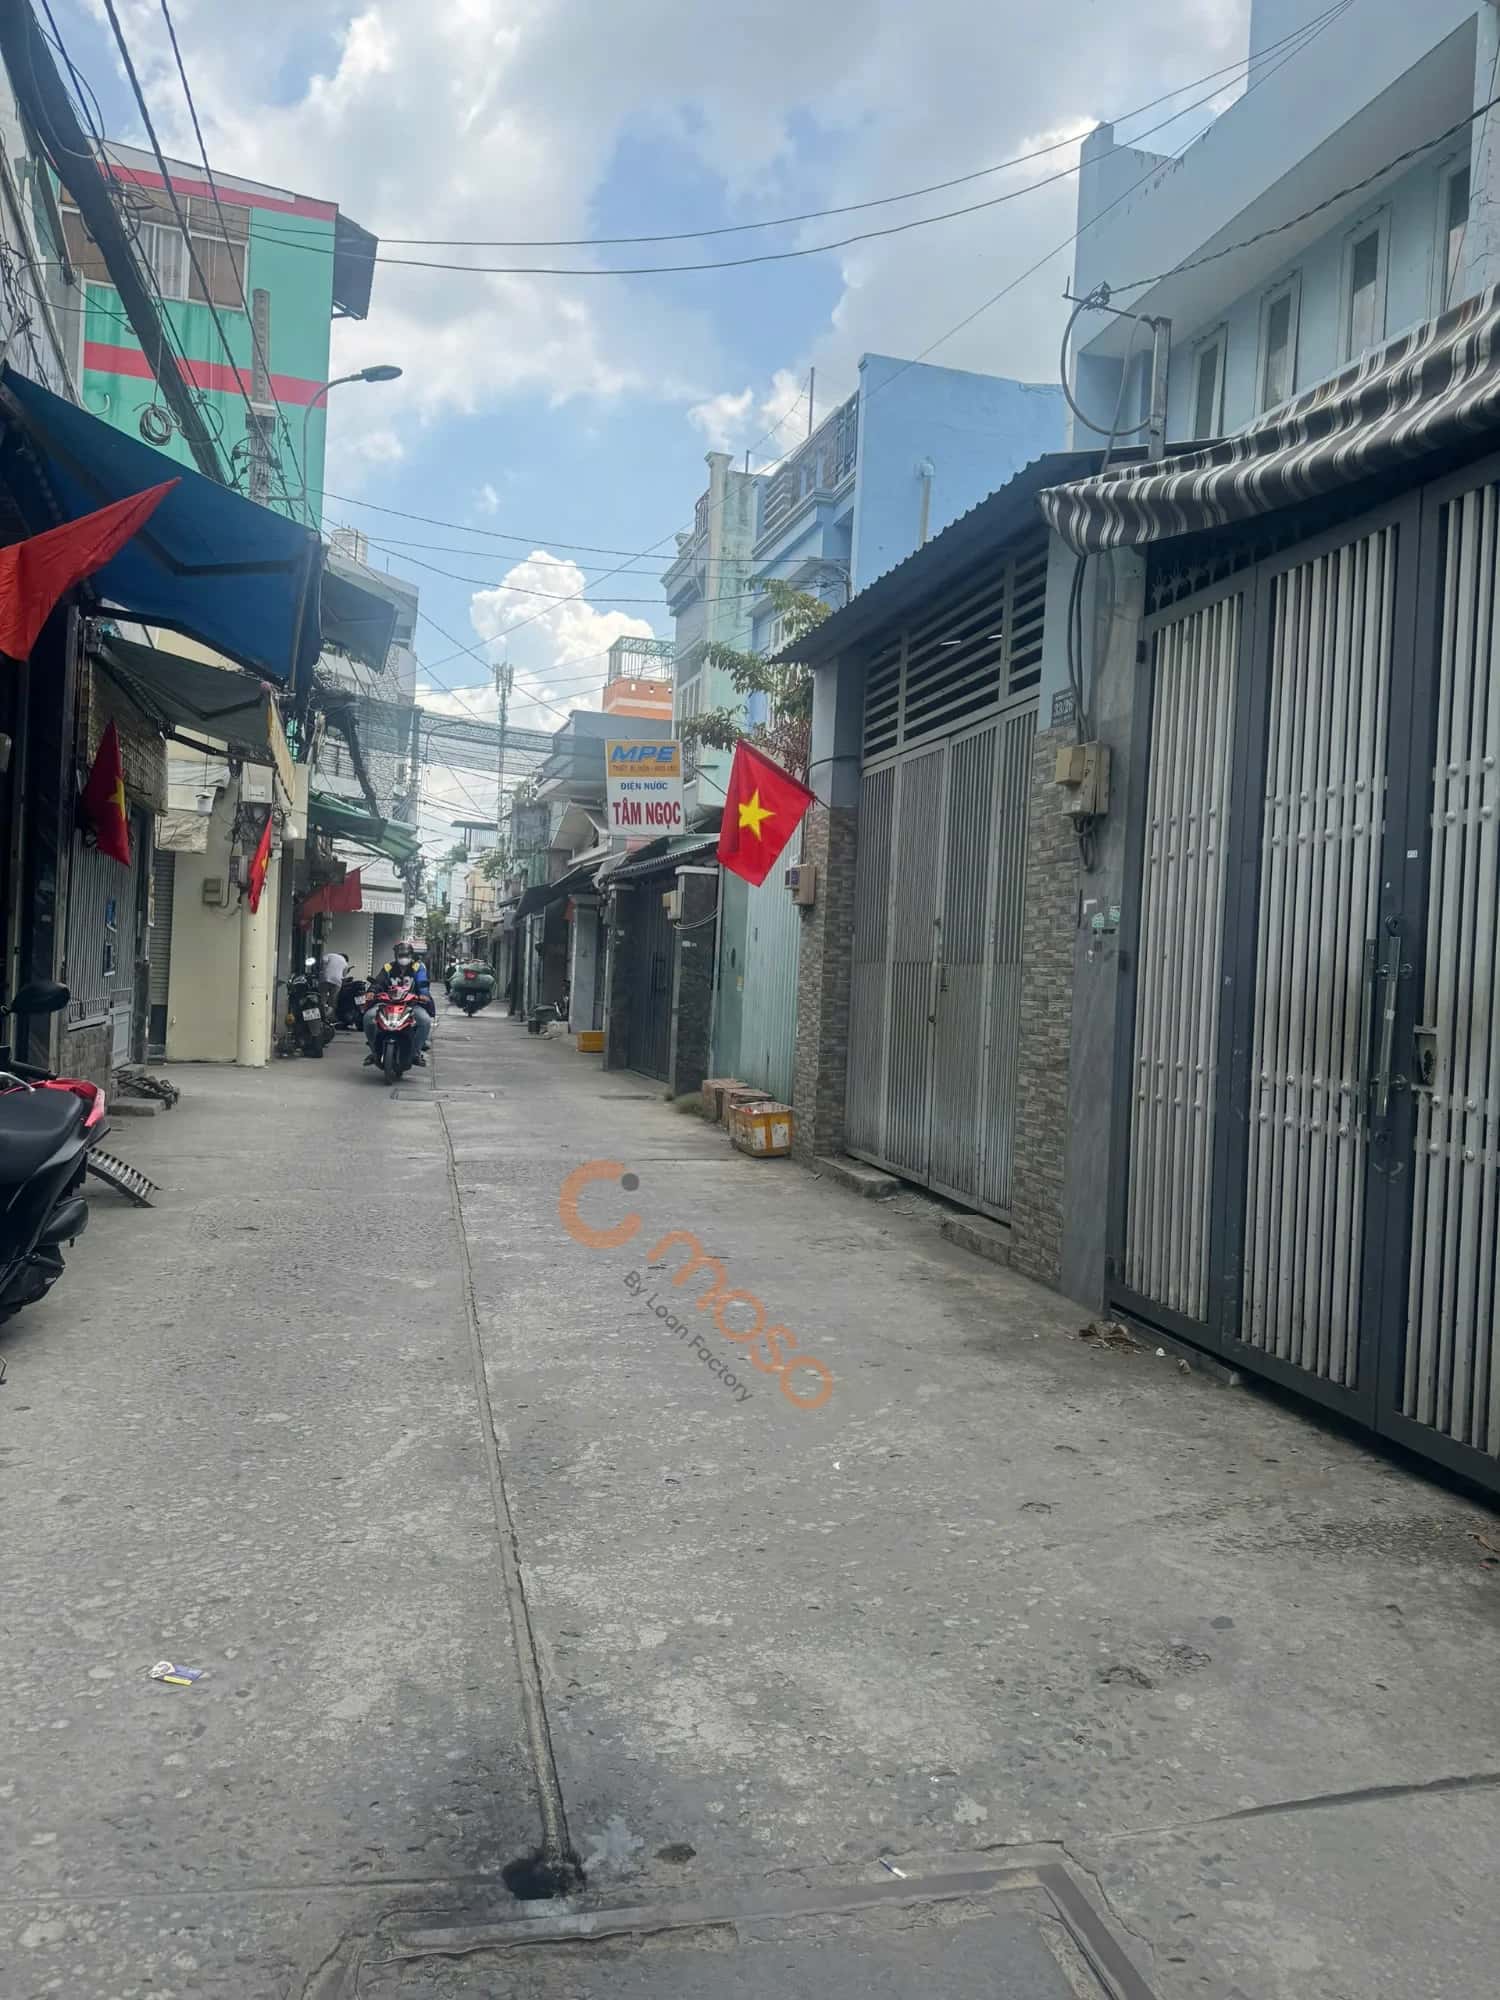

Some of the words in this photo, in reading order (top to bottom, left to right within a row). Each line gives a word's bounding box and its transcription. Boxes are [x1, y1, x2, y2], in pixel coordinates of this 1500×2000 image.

[611, 746, 676, 762] MPE
[612, 797, 641, 825] TÂM
[645, 801, 681, 830] NGỌC
